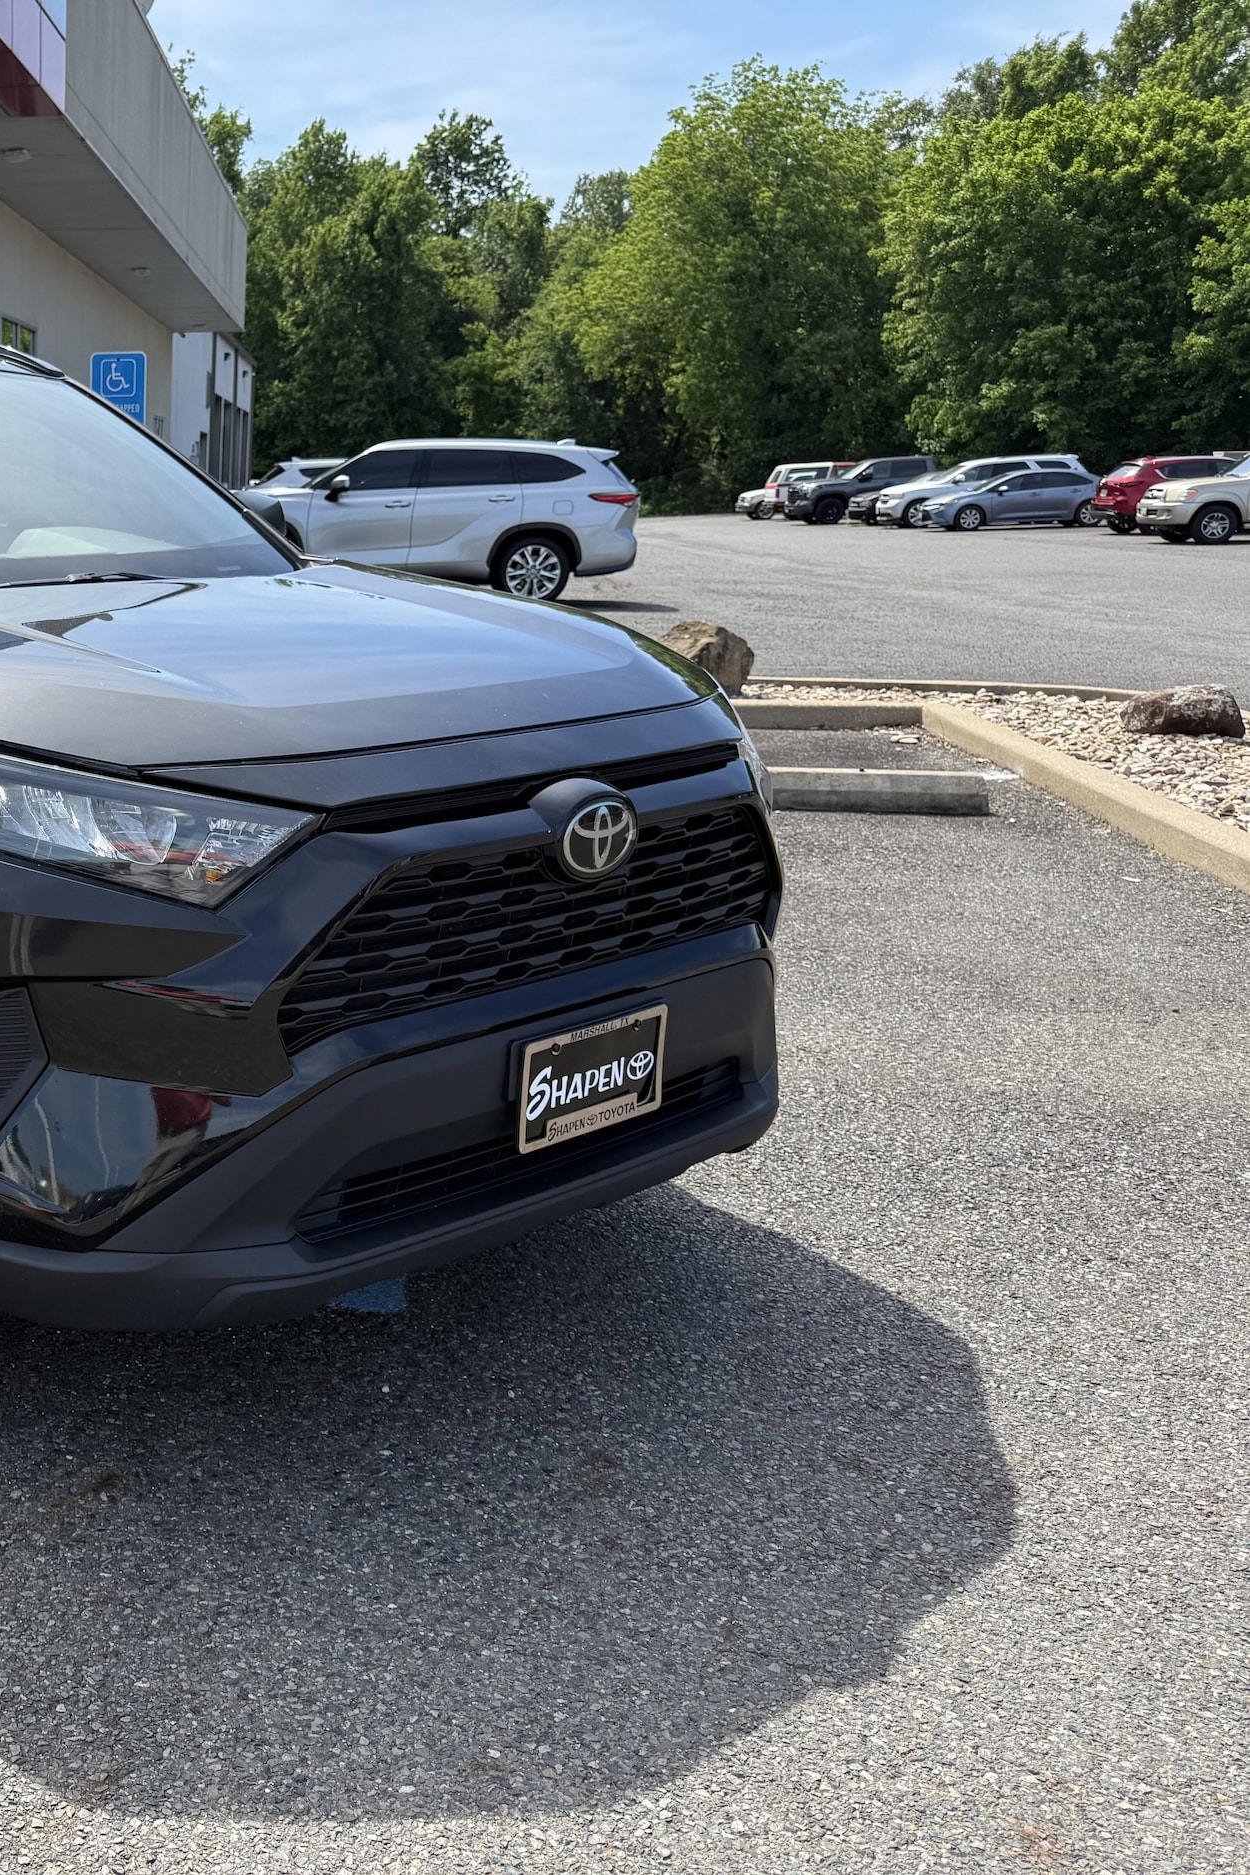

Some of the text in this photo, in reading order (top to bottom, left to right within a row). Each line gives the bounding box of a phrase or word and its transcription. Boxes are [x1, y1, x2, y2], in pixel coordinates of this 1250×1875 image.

[570, 1017, 630, 1042] MARSHALL, TX
[526, 1056, 625, 1121] SHAPEN
[598, 1101, 636, 1123] TOYOTA
